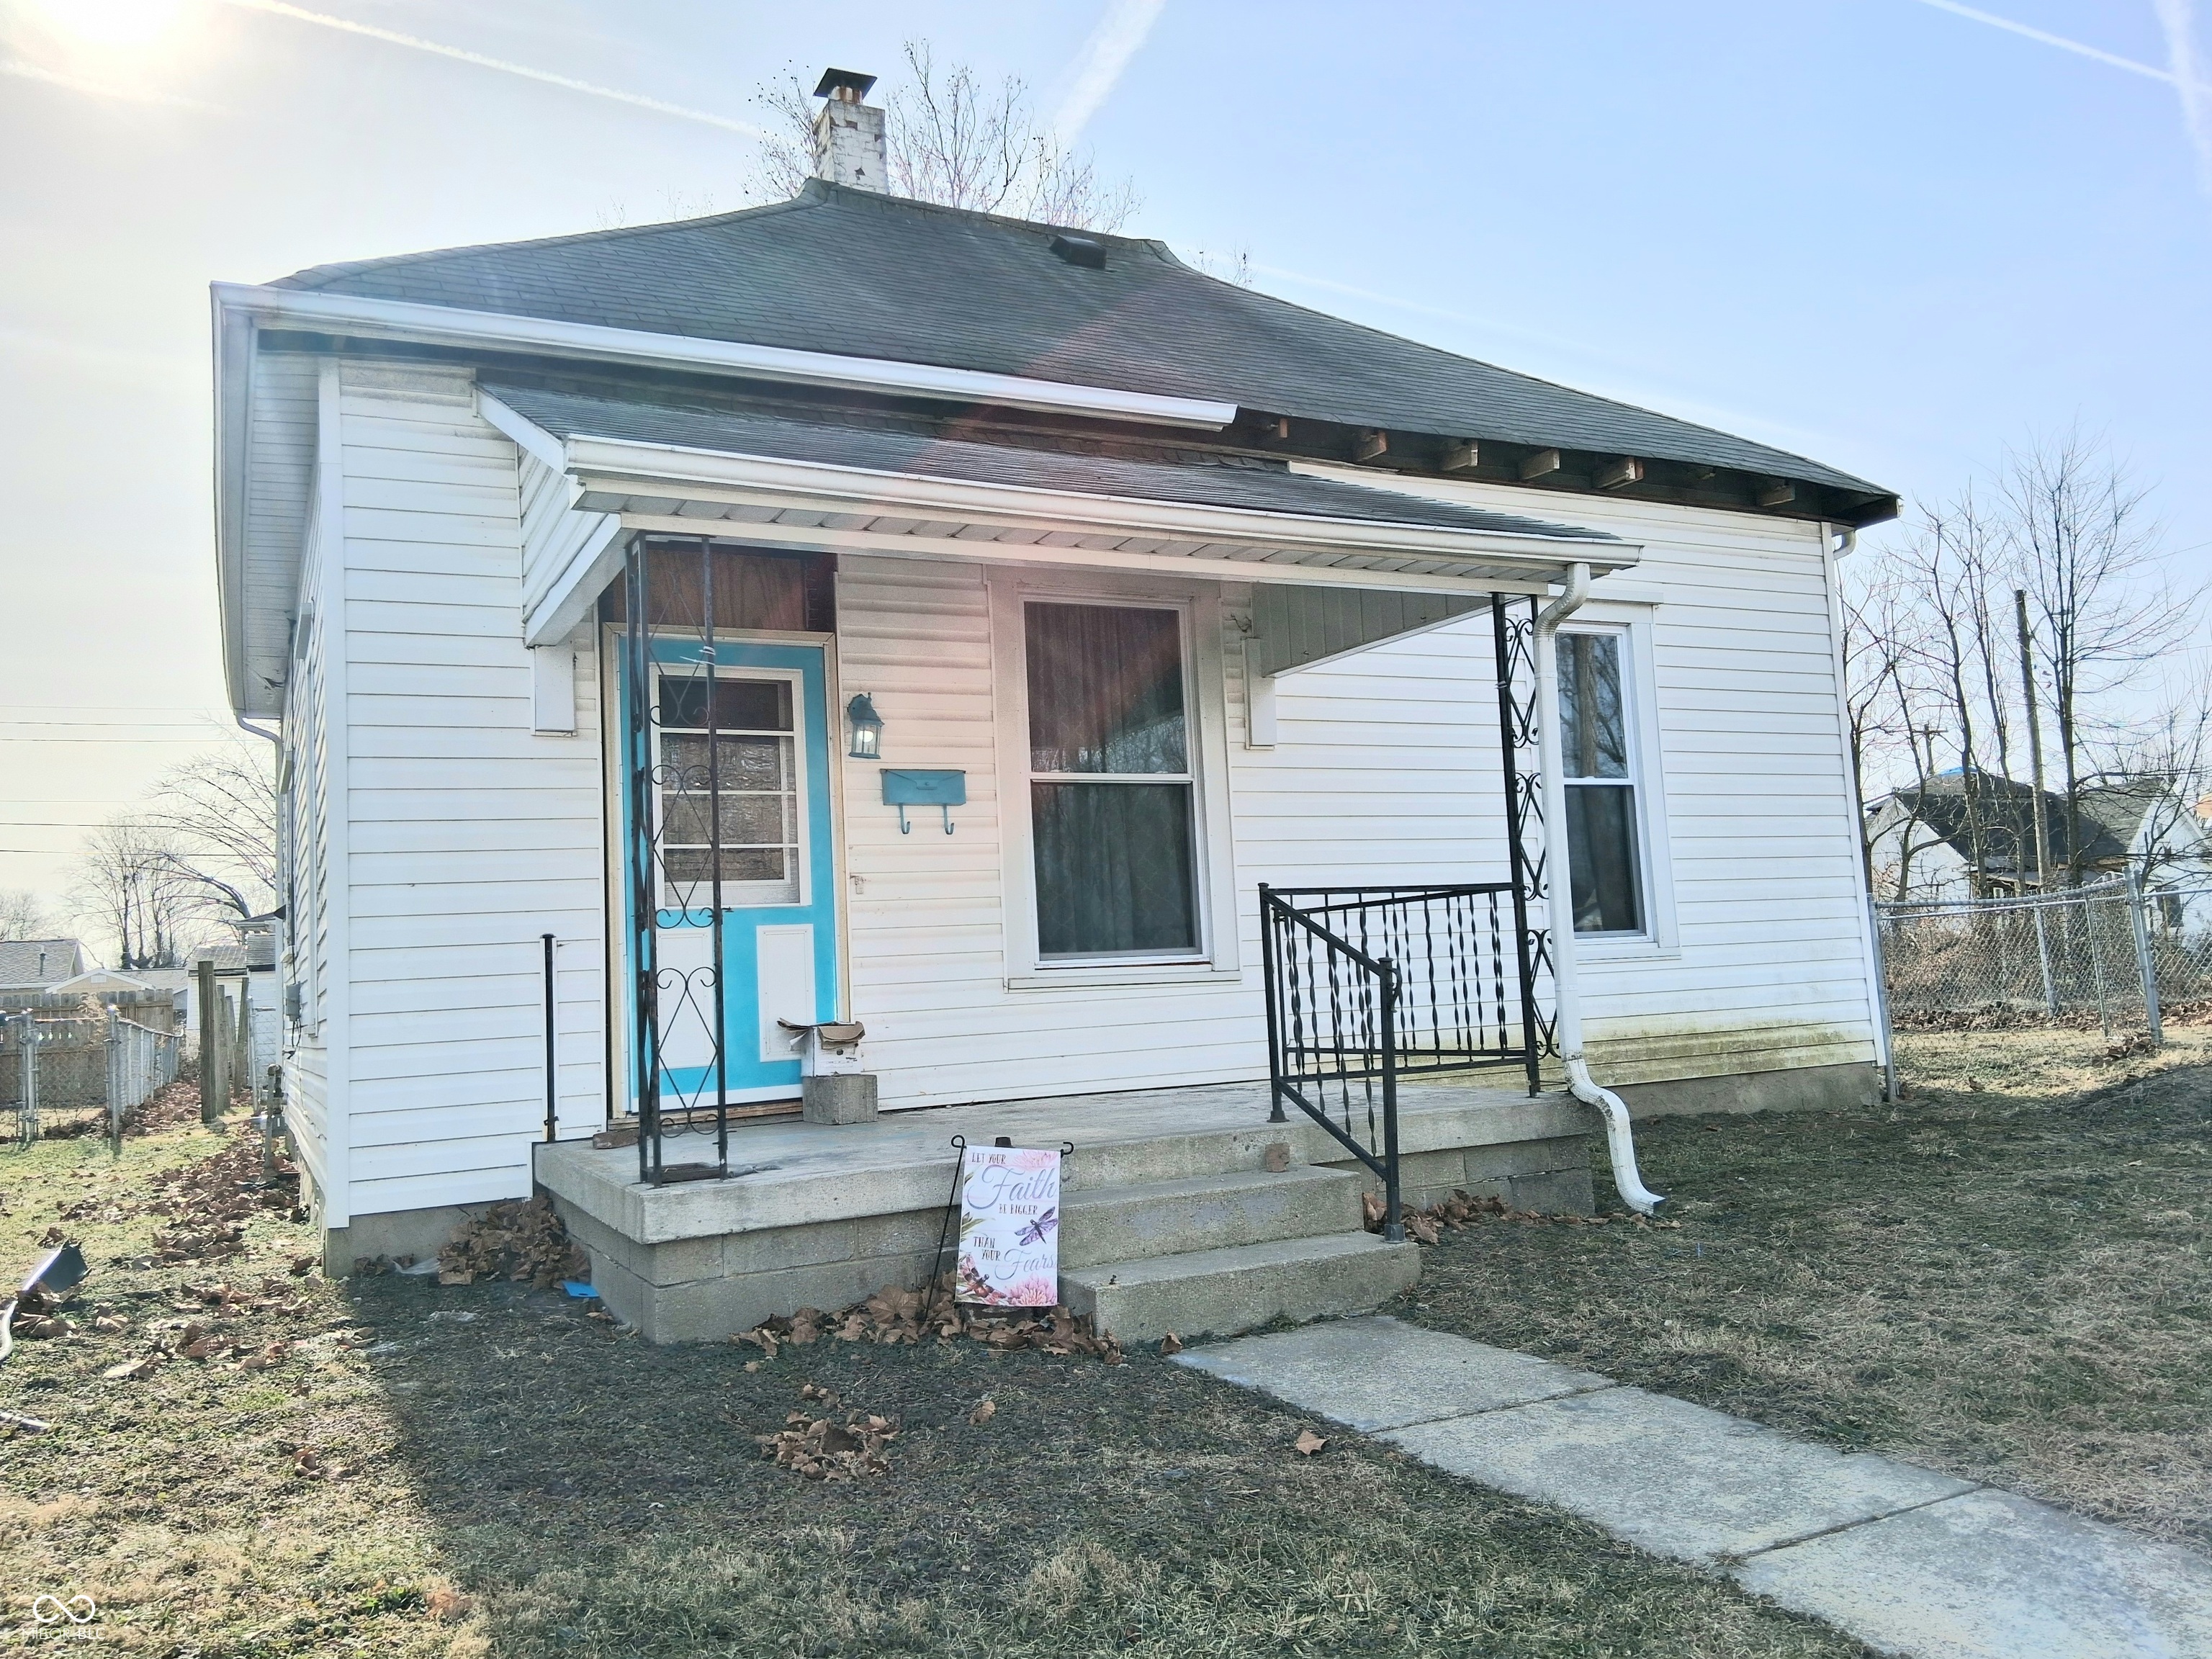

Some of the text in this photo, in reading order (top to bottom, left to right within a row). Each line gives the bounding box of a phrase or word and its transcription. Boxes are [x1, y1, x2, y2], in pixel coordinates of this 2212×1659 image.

[971, 1153, 1007, 1164] LET YOUR
[966, 1164, 1057, 1210] Faith
[999, 1203, 1038, 1215] BE BIGGER
[974, 1236, 995, 1249] THAN
[981, 1249, 1056, 1280] YOUR Fears
